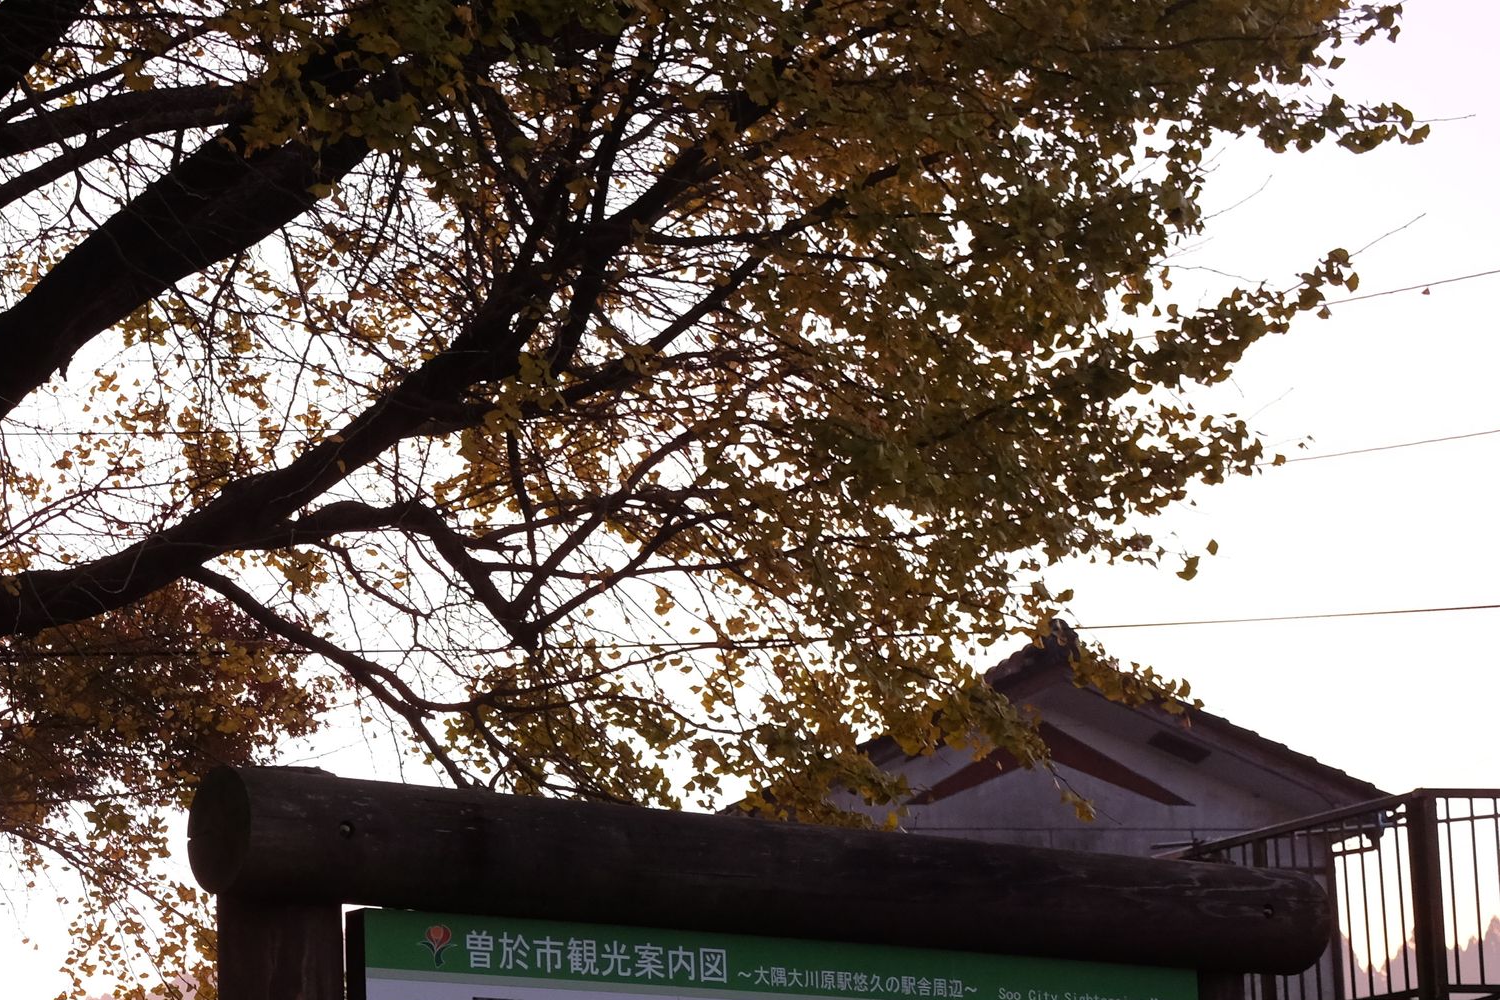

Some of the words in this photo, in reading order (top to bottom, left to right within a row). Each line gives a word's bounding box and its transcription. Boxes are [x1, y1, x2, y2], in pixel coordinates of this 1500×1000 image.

[465, 929, 728, 984] 曽於市観光案内図
